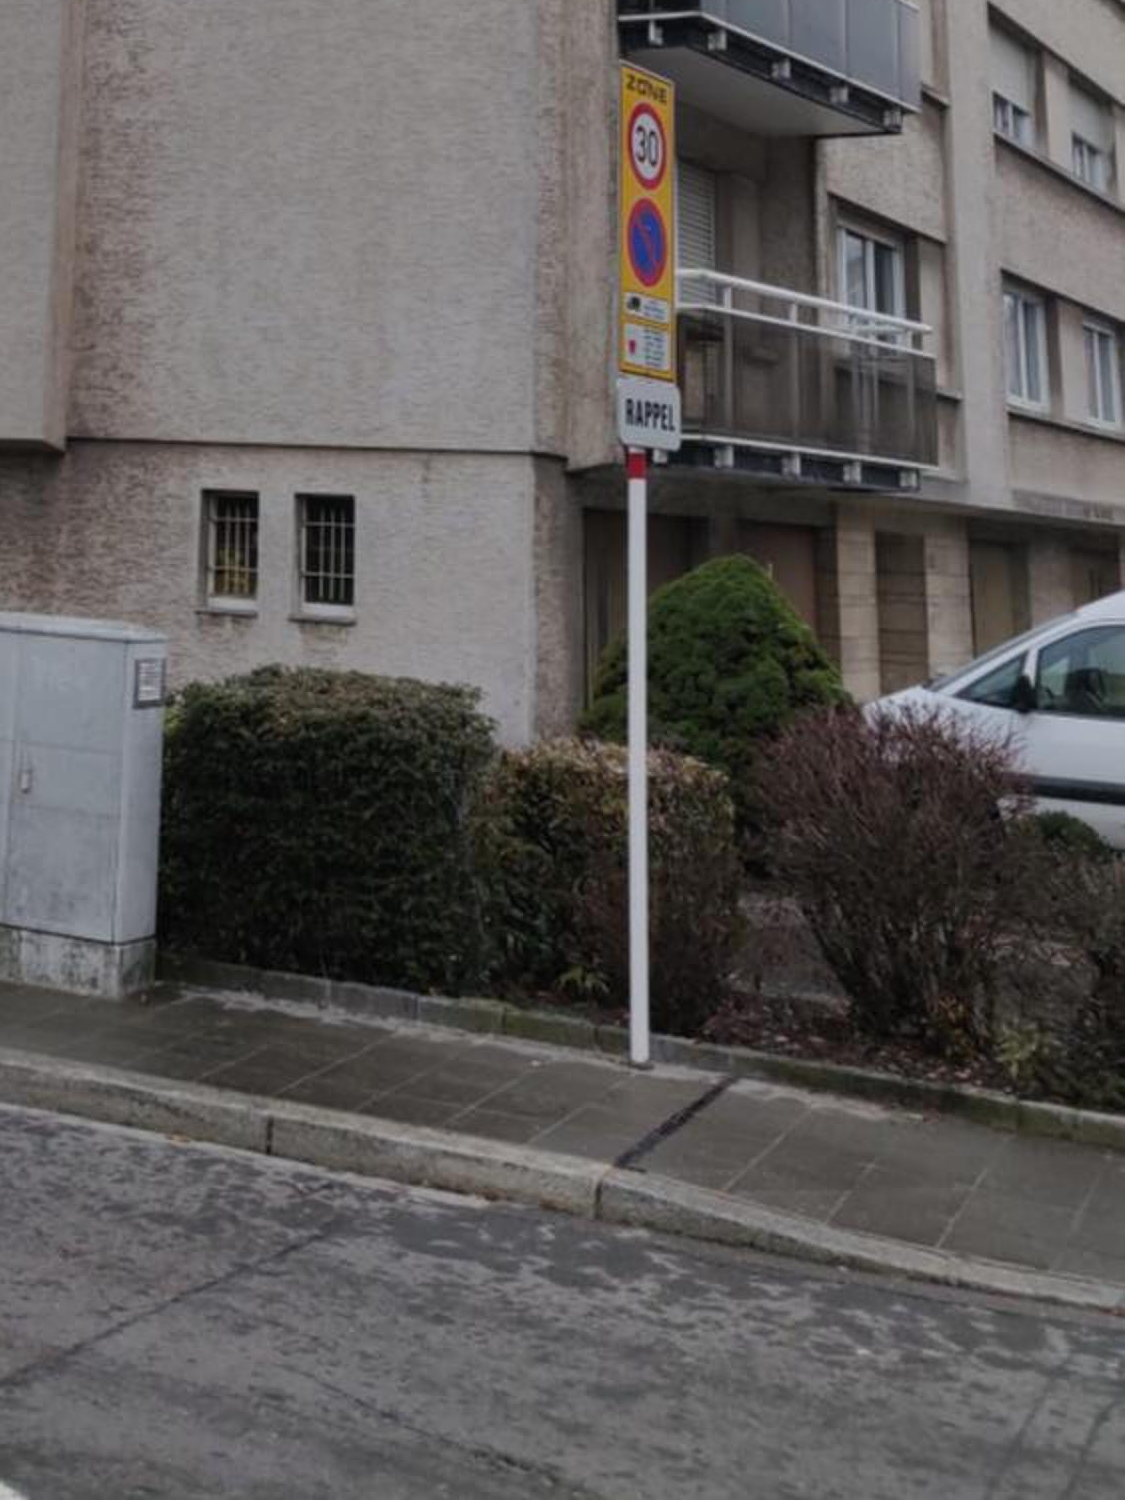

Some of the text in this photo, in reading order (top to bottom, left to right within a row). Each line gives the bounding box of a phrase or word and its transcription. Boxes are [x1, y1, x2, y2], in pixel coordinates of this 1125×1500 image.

[626, 73, 668, 104] ZONE
[635, 125, 660, 167] 30
[626, 398, 676, 432] RAPPEL
